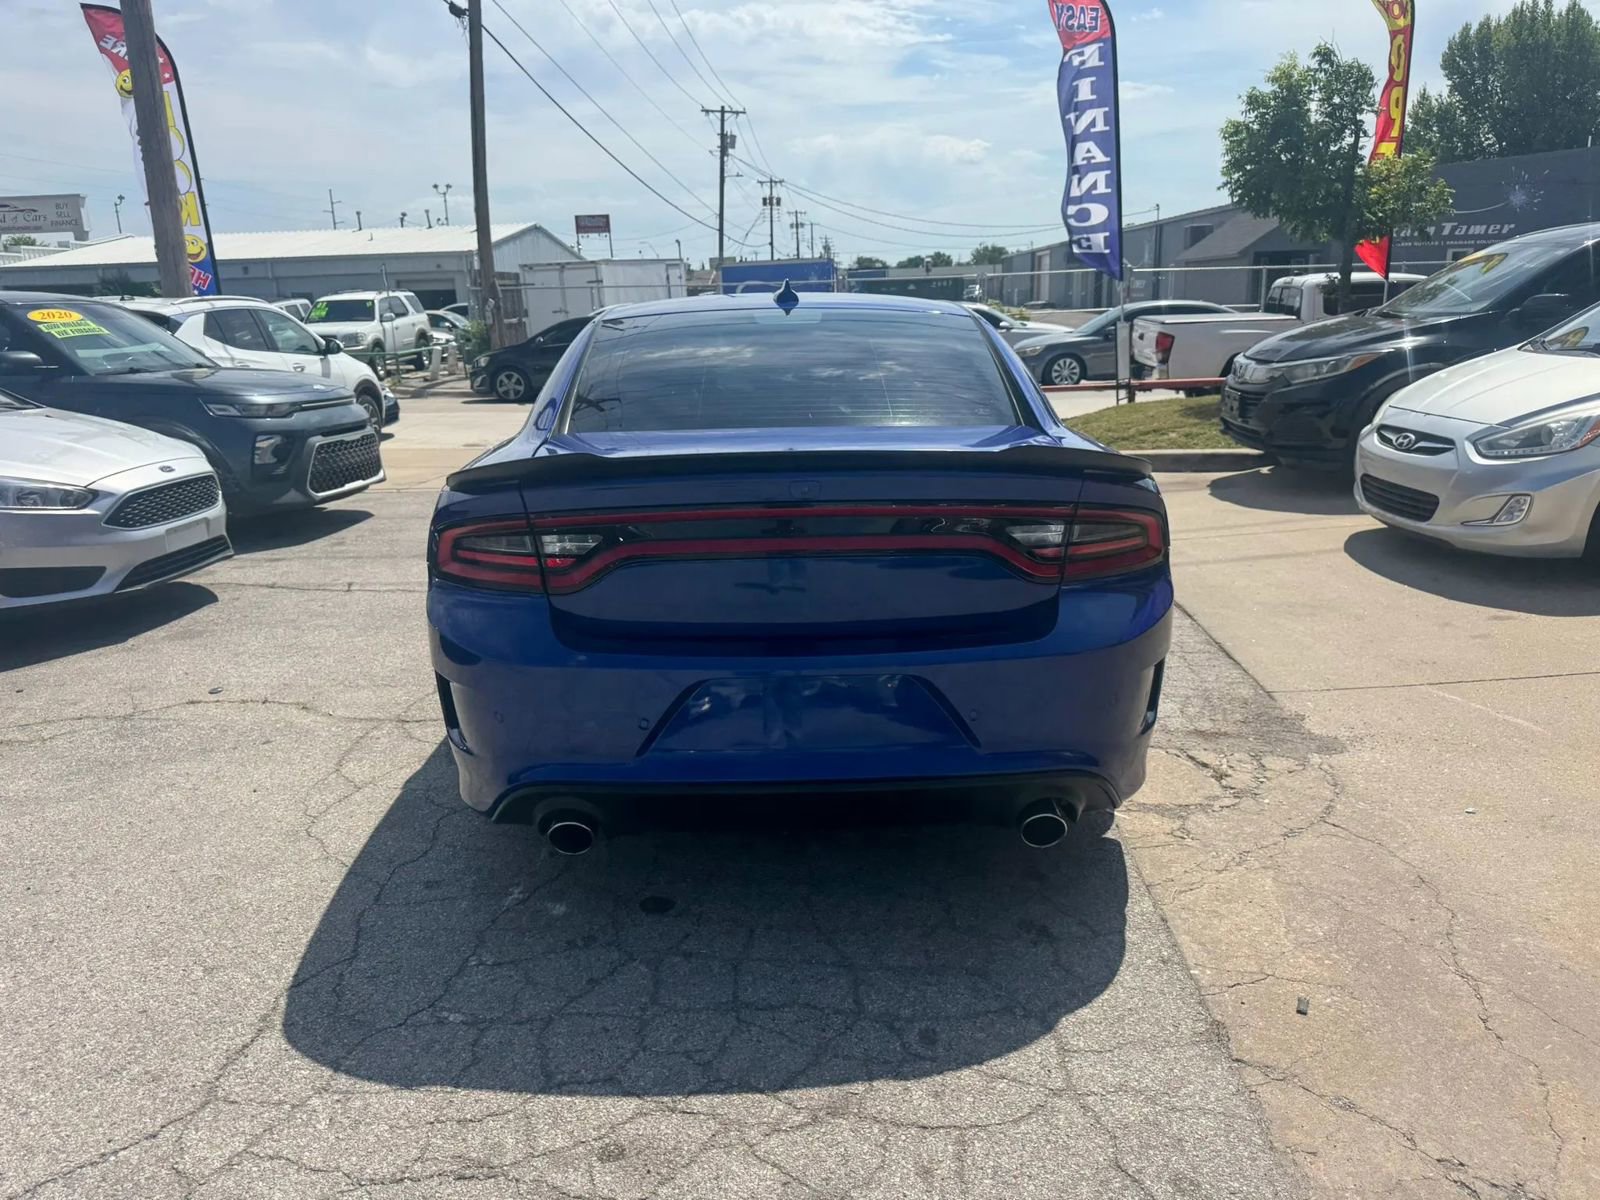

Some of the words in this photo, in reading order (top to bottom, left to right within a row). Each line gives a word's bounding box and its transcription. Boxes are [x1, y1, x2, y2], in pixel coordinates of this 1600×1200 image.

[23, 211, 47, 223] Cars
[1441, 222, 1516, 236] Tamer
[40, 311, 73, 320] 2020
